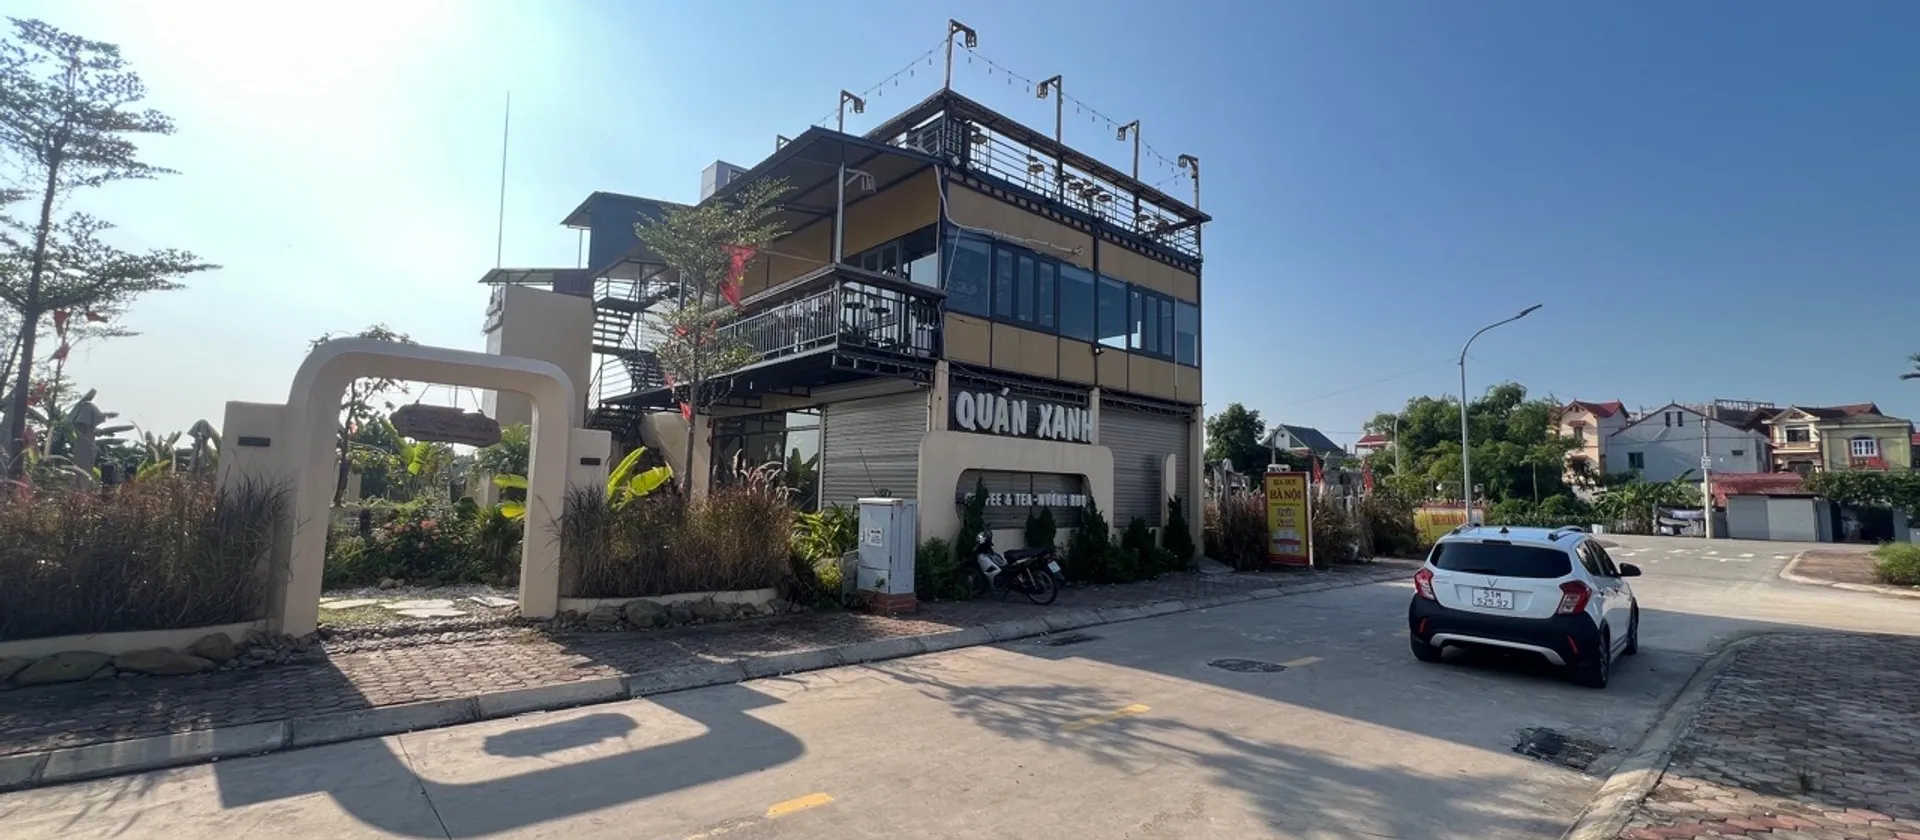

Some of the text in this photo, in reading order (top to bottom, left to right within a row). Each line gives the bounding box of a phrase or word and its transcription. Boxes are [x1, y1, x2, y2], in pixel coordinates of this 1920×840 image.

[956, 387, 1093, 442] QUÁN XANH
[964, 492, 1002, 507] CFEE
[1004, 493, 1013, 506] &
[1270, 487, 1301, 501] HÀ NỘI
